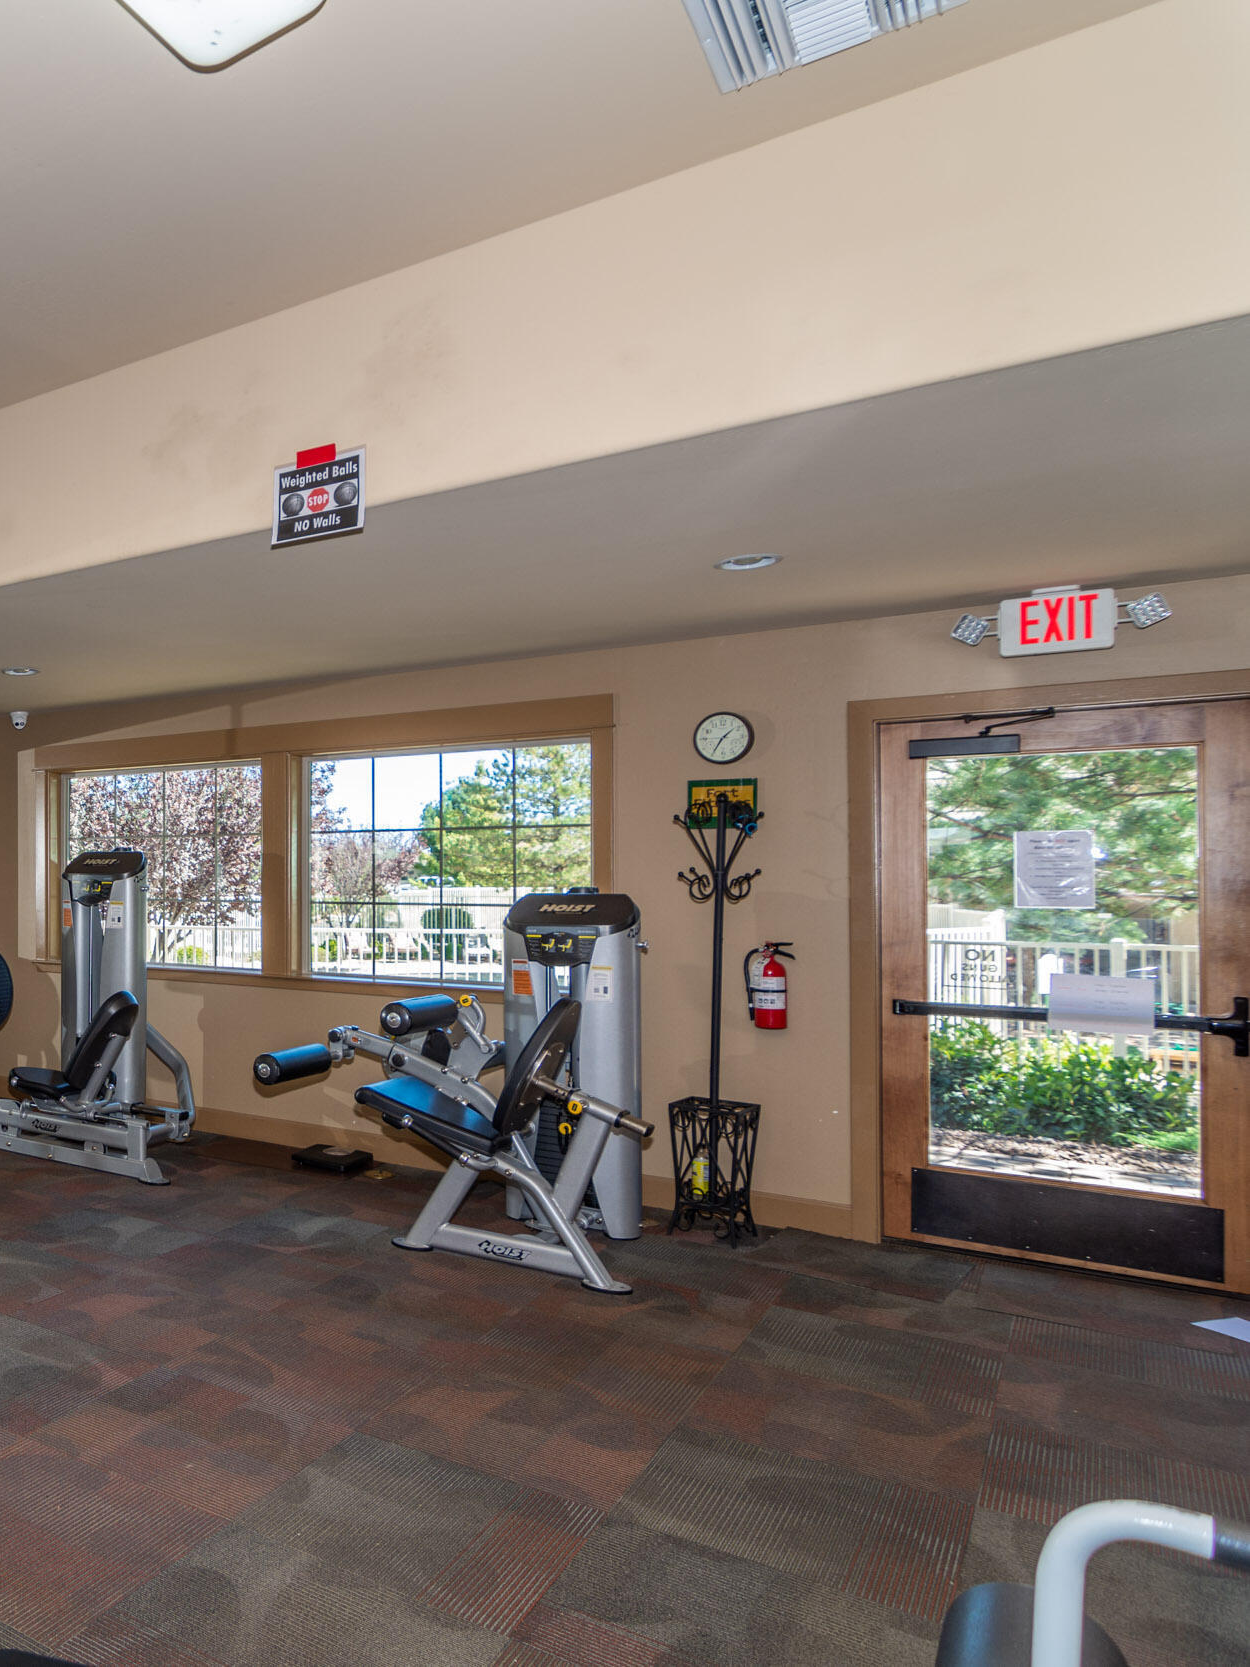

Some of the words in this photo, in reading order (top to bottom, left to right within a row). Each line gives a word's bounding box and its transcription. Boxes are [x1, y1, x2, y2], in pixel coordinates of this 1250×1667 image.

[281, 467, 329, 489] Weighted
[332, 461, 358, 478] Balls
[307, 493, 329, 507] STOP
[294, 521, 310, 533] NO
[313, 513, 341, 528] Walls
[1019, 593, 1099, 645] EXIT
[538, 903, 597, 912] HOIST
[478, 1240, 532, 1260] HOIST
